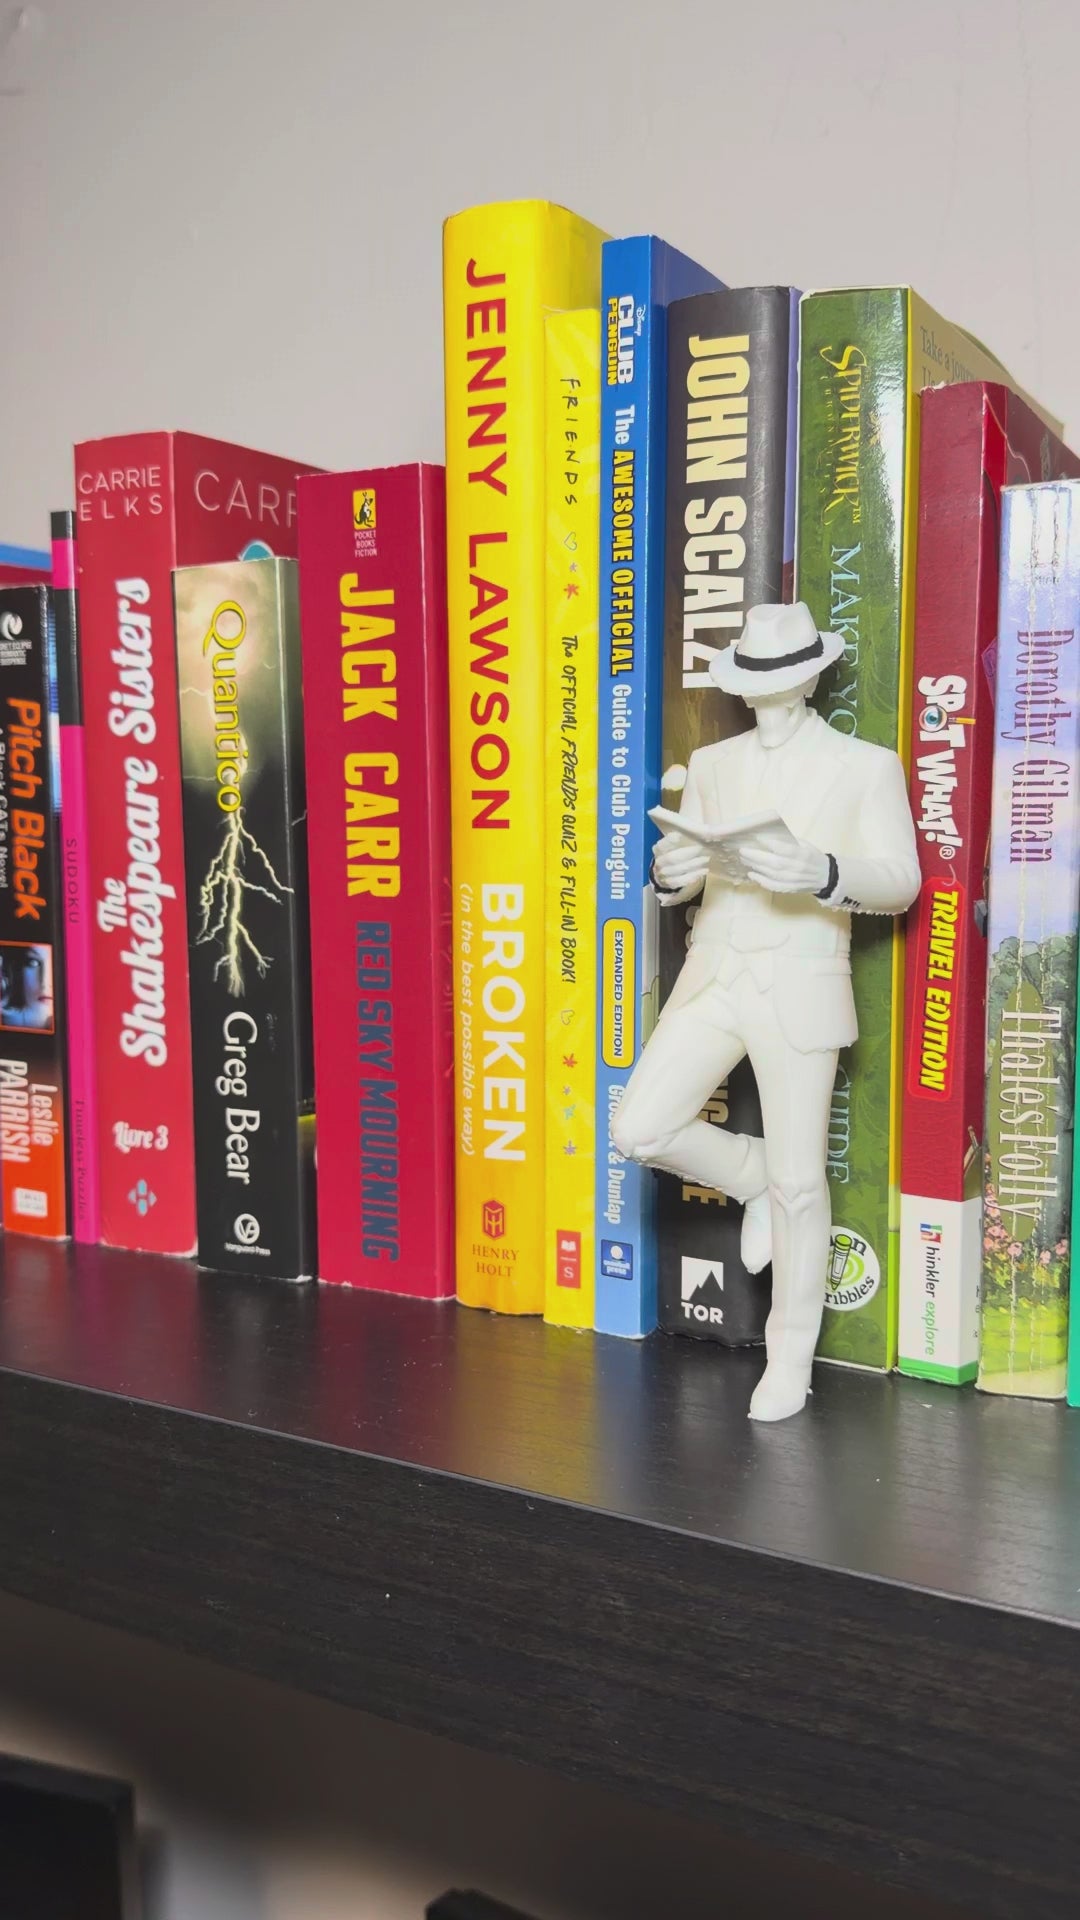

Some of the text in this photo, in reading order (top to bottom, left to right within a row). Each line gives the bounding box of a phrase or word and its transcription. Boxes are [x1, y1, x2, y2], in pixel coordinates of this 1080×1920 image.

[607, 297, 618, 386] PENGUIN
[618, 295, 634, 384] CLUB
[560, 377, 581, 506] FRIENDS
[686, 333, 751, 484] JOHN
[79, 466, 161, 494] CARRIE
[81, 496, 163, 521] ELKS
[354, 530, 376, 540] POCKET
[355, 539, 375, 549] BOOKS
[355, 548, 377, 558] FICTION
[466, 258, 510, 829] JENNY LAWSON
[203, 600, 249, 812] Quantico
[604, 404, 635, 901] The AWESOME OFFICIAL Guide to Club Penguin
[1001, 629, 1075, 747] Dorothy
[8, 697, 43, 799] Pitch
[339, 573, 401, 898] JACK CARR
[11, 808, 47, 920] Black
[97, 578, 176, 1067] The Shakespeare Sisters
[559, 635, 579, 985] The OFFICIAL FRIENDS QUIZ & FILL-IN BOOK!
[1009, 759, 1071, 864] Gilman
[67, 838, 78, 924] SUDOKU
[460, 881, 476, 1157] (in the best possible way)
[481, 883, 526, 1161] BROKEN
[613, 929, 625, 1057] EXPANDED EDITION
[919, 890, 958, 1092] TRAVEL EDITION
[0, 1058, 31, 1163] PARRISH
[30, 1083, 58, 1146] Leslie
[153, 1125, 169, 1151] 3
[215, 1011, 260, 1185] Greg Bear
[356, 921, 399, 1262] RED SKY MOURNING
[983, 1006, 1063, 1222] Thale's Folly
[603, 1168, 626, 1224] Dunlap
[472, 1243, 520, 1262] HENRY
[476, 1261, 514, 1278] HOLT
[921, 1246, 941, 1355] hinkler explore
[681, 1301, 724, 1325] TOR
